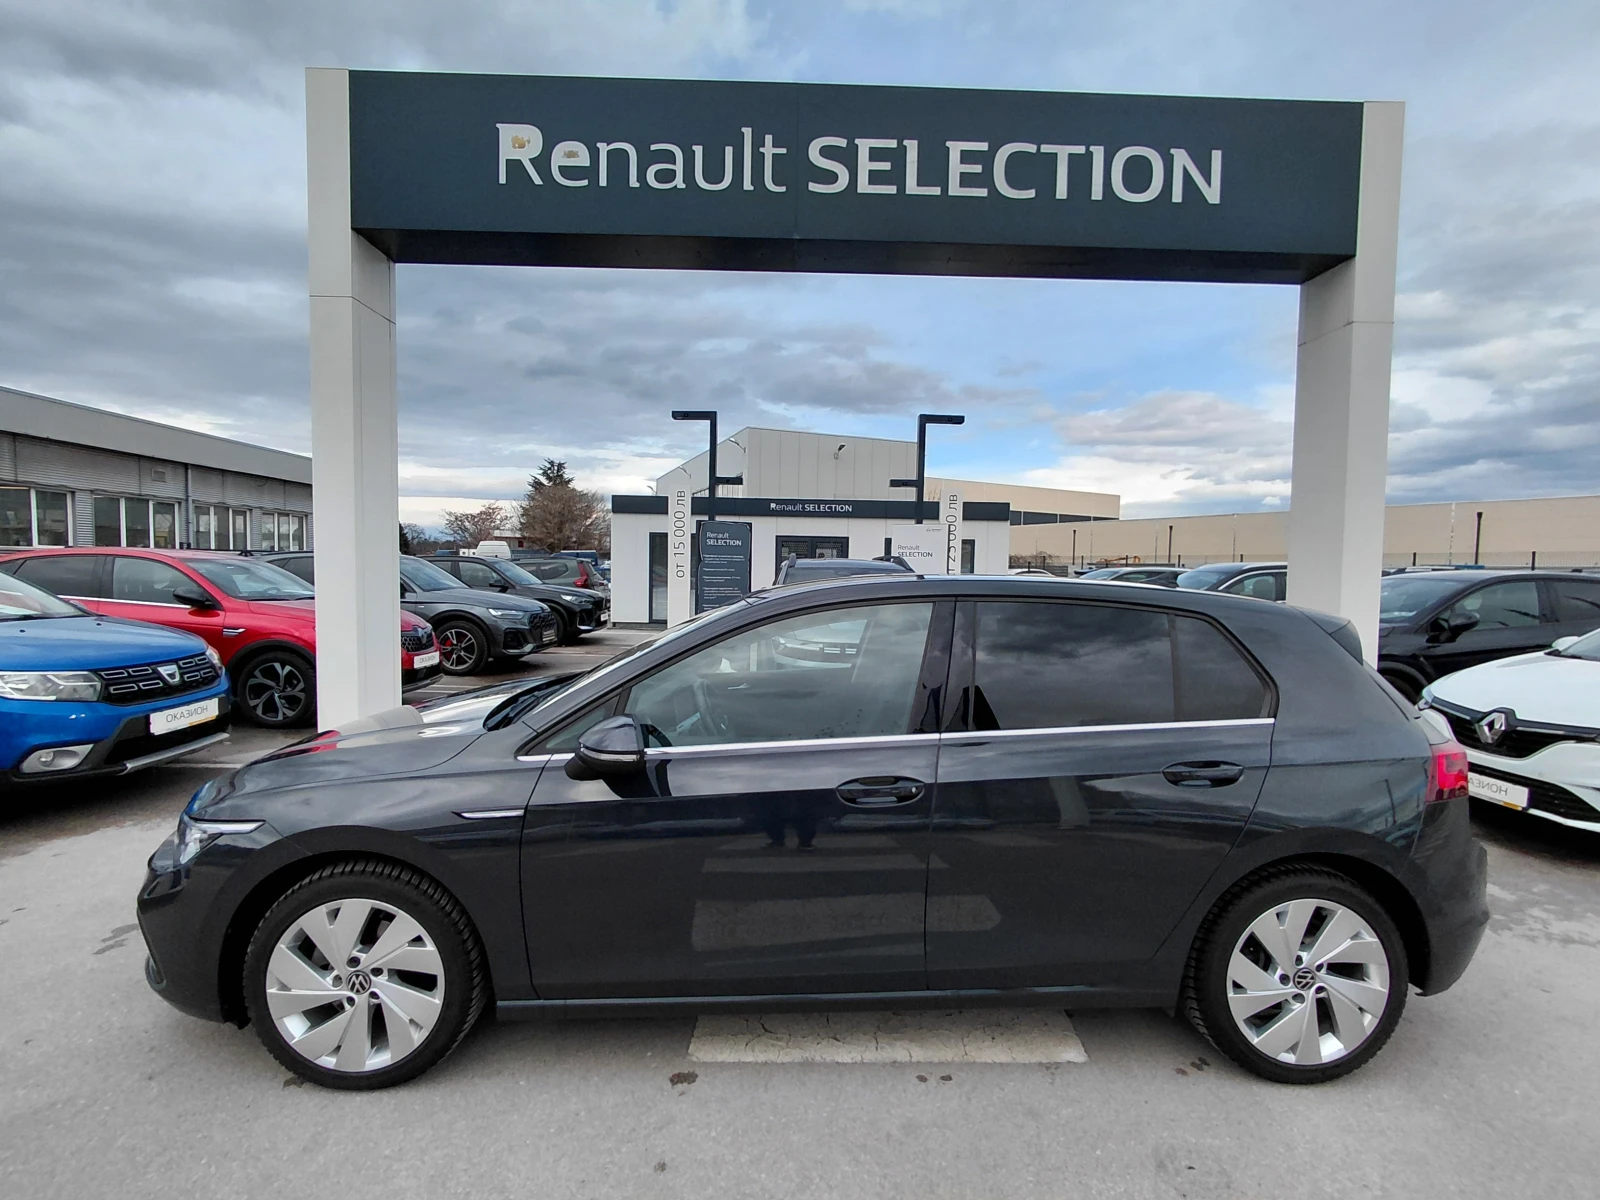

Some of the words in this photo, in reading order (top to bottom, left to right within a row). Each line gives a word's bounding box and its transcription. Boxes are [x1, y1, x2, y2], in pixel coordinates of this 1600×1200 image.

[496, 122, 787, 193] Renault
[807, 136, 1222, 205] SELECTION
[770, 503, 803, 511] Renault
[804, 504, 852, 512] SELECTION
[674, 511, 685, 537] 000
[674, 542, 685, 557] 15
[165, 705, 208, 723] ОКАЗИОН
